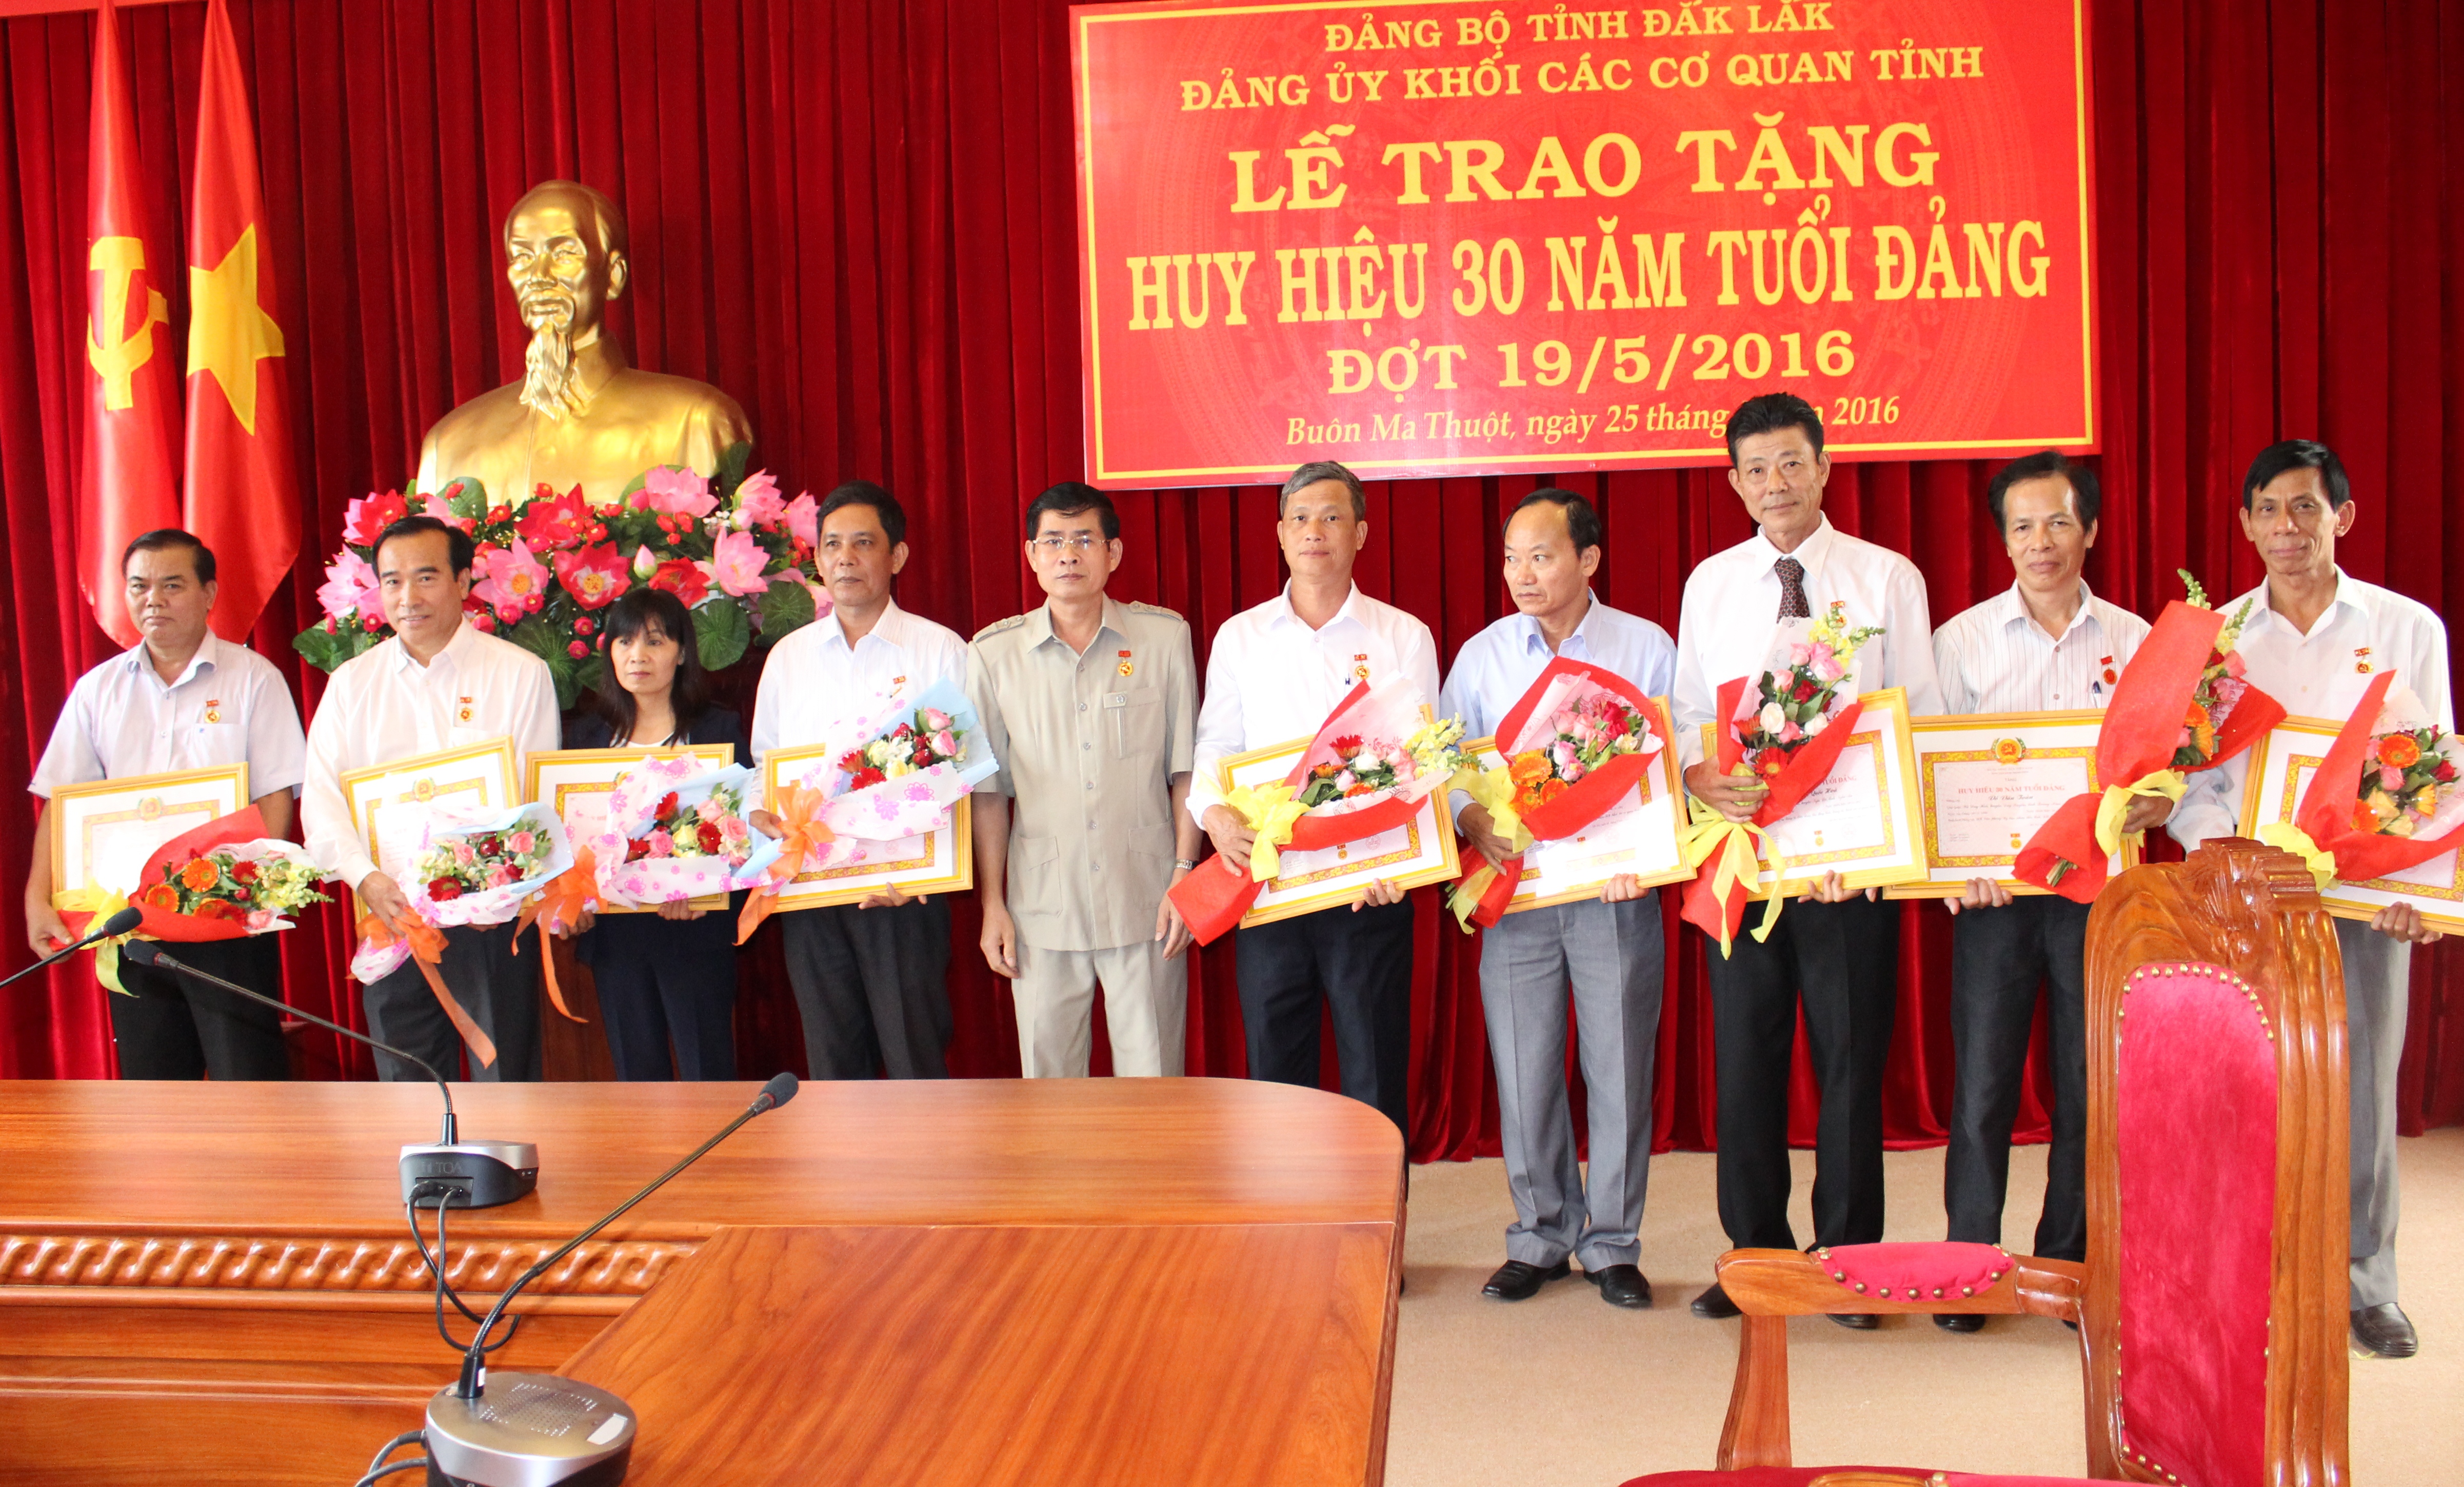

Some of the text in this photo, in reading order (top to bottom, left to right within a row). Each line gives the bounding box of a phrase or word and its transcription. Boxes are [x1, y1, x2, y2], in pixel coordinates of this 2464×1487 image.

[1324, 0, 1834, 52] ĐẢNG BỘ TỈNH ĐẮK LẮK
[1180, 38, 1984, 111] ĐẢNG ỦY KHỐI CÁC CƠ QUAN TỈNH
[1228, 111, 1940, 213] LỄ TRAO TẶNG
[1126, 194, 2051, 338] HUY HIỆU 30 NĂM TUỔI ĐẢNG
[1326, 330, 1855, 403] ĐỢT 19/5/2016
[1285, 417, 1361, 446] Buôn
[1369, 413, 1417, 441] Ma
[1423, 410, 1517, 443] Thuột,
[1525, 408, 1598, 445] ngày
[1604, 404, 1640, 433] 25
[1646, 402, 1730, 439] tháng
[1832, 395, 1899, 425] 2016
[435, 1161, 463, 1174] TOA
